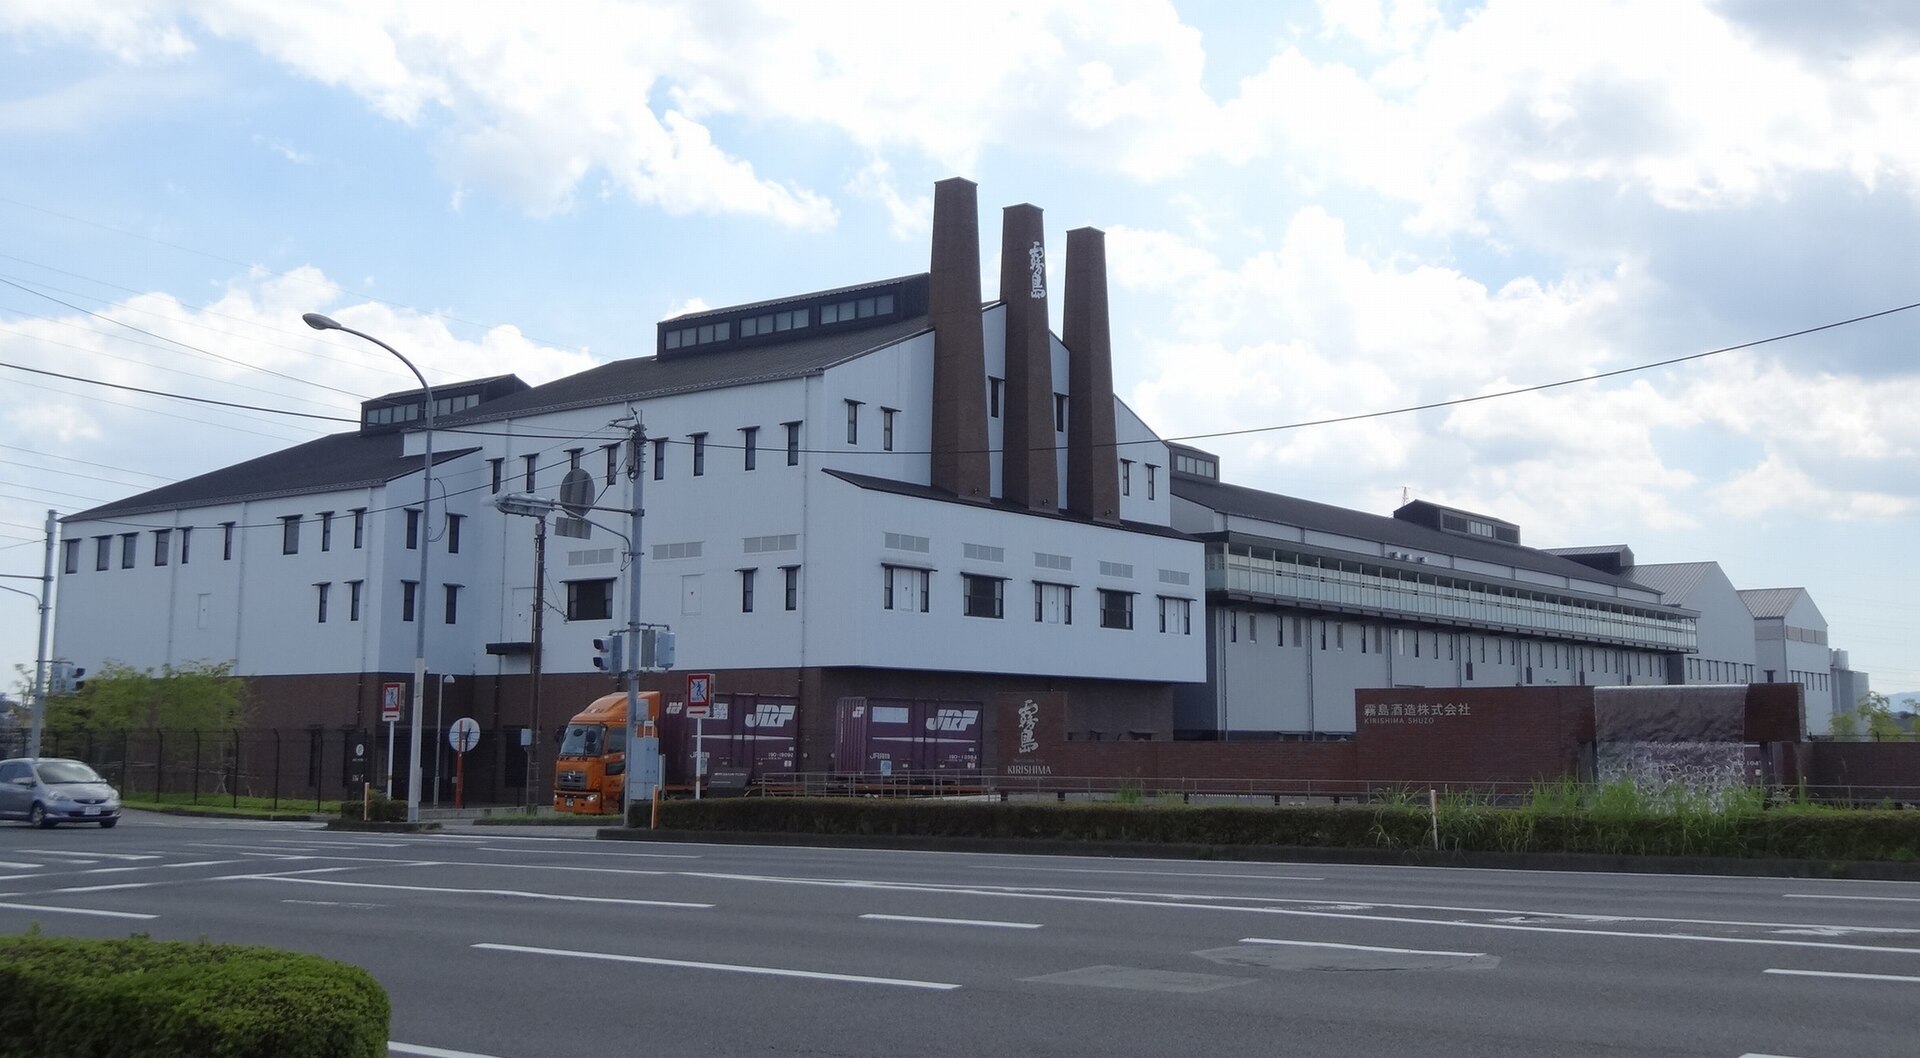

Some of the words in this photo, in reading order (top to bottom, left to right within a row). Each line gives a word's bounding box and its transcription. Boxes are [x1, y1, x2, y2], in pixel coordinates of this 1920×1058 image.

[745, 704, 796, 728] JRF
[1364, 703, 1471, 716] 霧島酒造株式会社
[926, 709, 979, 731] JRF
[1007, 765, 1052, 775] KIRISHIMA
